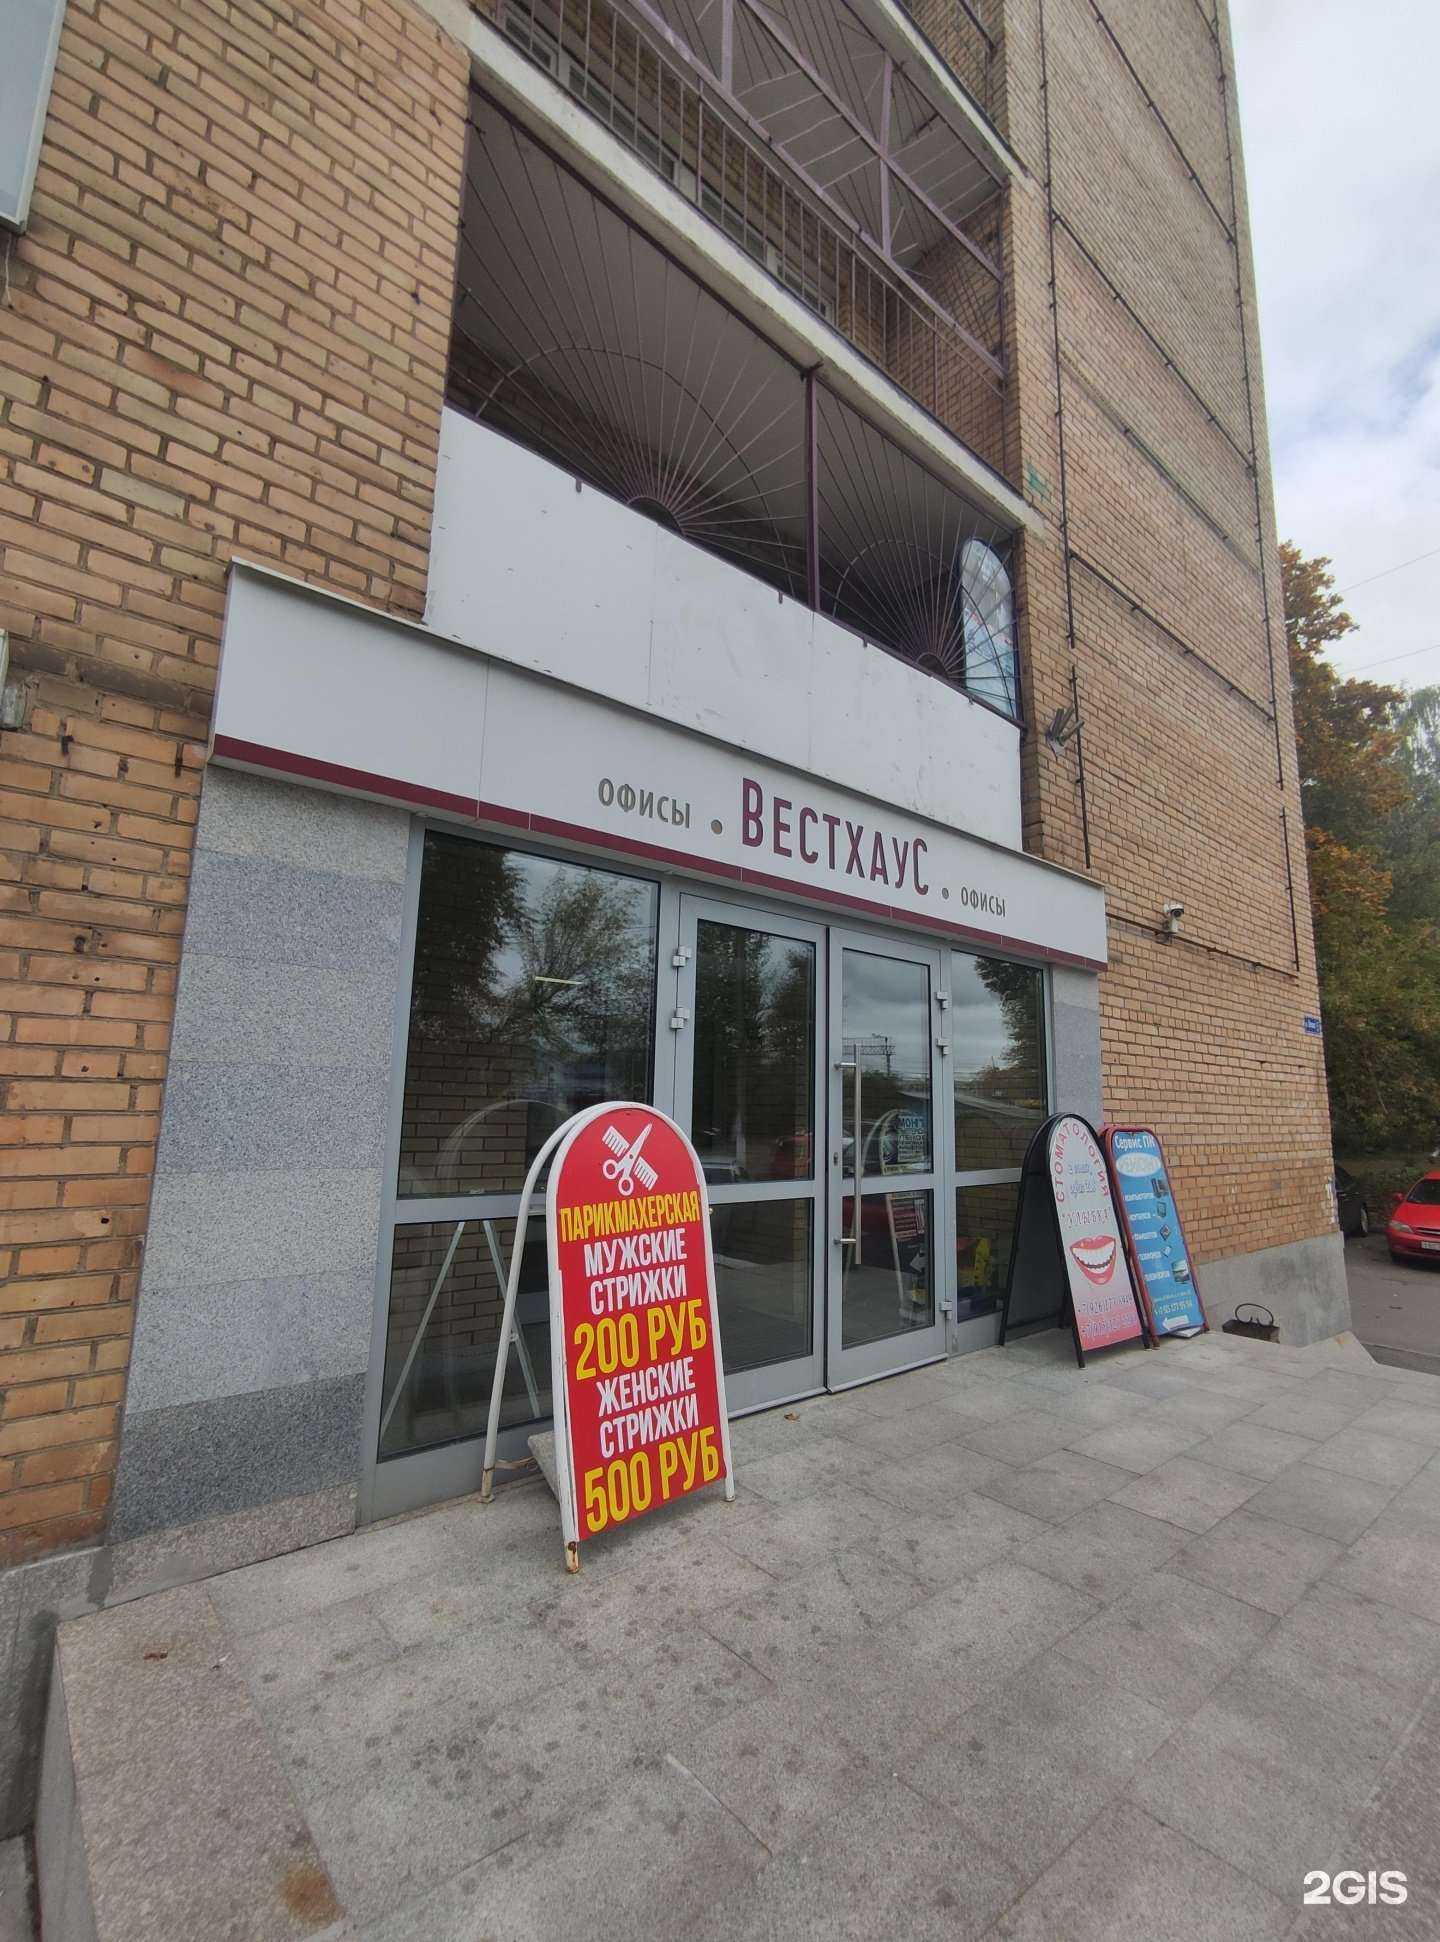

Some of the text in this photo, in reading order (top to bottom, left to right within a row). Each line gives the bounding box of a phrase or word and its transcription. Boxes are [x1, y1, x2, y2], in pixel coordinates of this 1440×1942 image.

[598, 777, 1007, 918] ОФИСЫ ВЕСТХАУС ОФИСЫ
[1055, 1122, 1109, 1203] СТОМАТОЛОГИЯ
[1114, 1135, 1142, 1152] Сервис
[559, 1189, 701, 1243] ПАРИКМАХЕРСКАЯ
[583, 1227, 688, 1279] МУЖСКИЕ
[589, 1264, 688, 1316] СТРИЖКИ
[573, 1298, 708, 1382] 200 РУБ
[595, 1355, 697, 1419] ЖЕНСКИЕ
[599, 1393, 700, 1459] СТРИЖКИ
[584, 1425, 721, 1533] 500 РУБ
